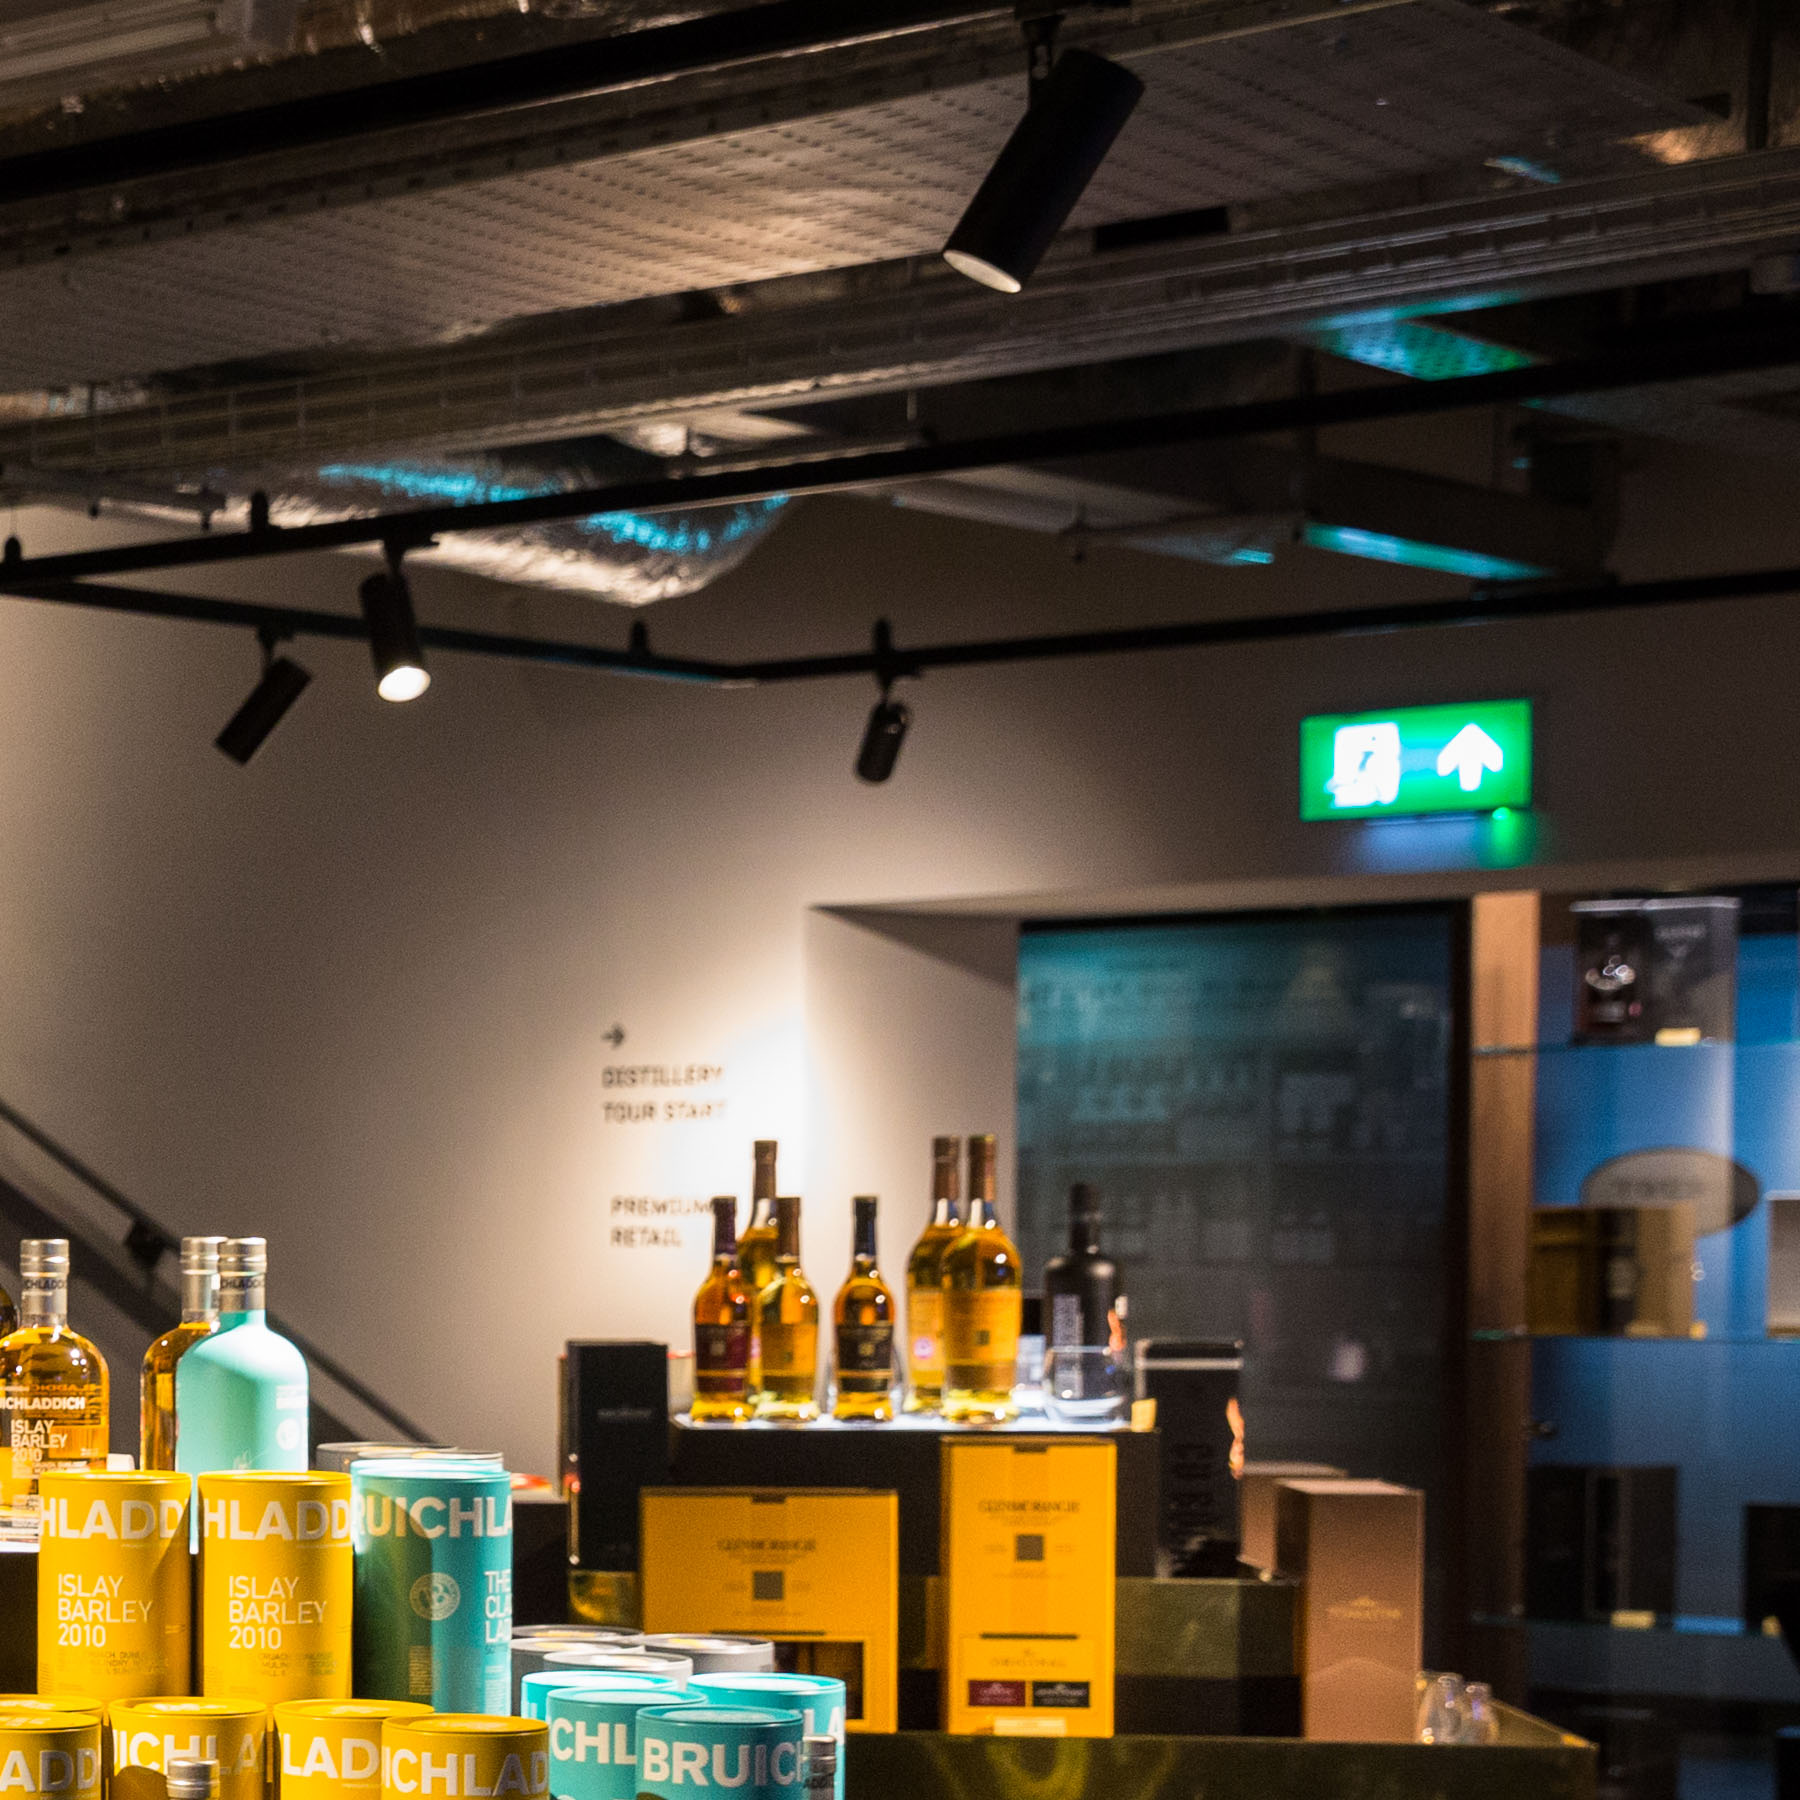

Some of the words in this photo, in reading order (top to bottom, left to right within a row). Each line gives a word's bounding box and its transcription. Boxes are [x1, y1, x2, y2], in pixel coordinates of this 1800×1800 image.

[602, 1065, 723, 1088] DISTILLERY
[603, 1101, 657, 1123] TOUR
[664, 1101, 726, 1123] START
[611, 1197, 714, 1217] PREMIUM
[611, 1227, 682, 1247] RETAIL
[11, 1419, 55, 1434] ISLAY
[11, 1433, 68, 1449] BARLEY
[11, 1448, 43, 1463] 2010
[58, 1574, 124, 1598] ISLAY
[229, 1575, 300, 1600] ISLAY
[58, 1599, 152, 1624] BARLEY
[229, 1600, 327, 1625] BARLEY
[58, 1623, 107, 1647] 2010
[229, 1626, 282, 1649] 2010
